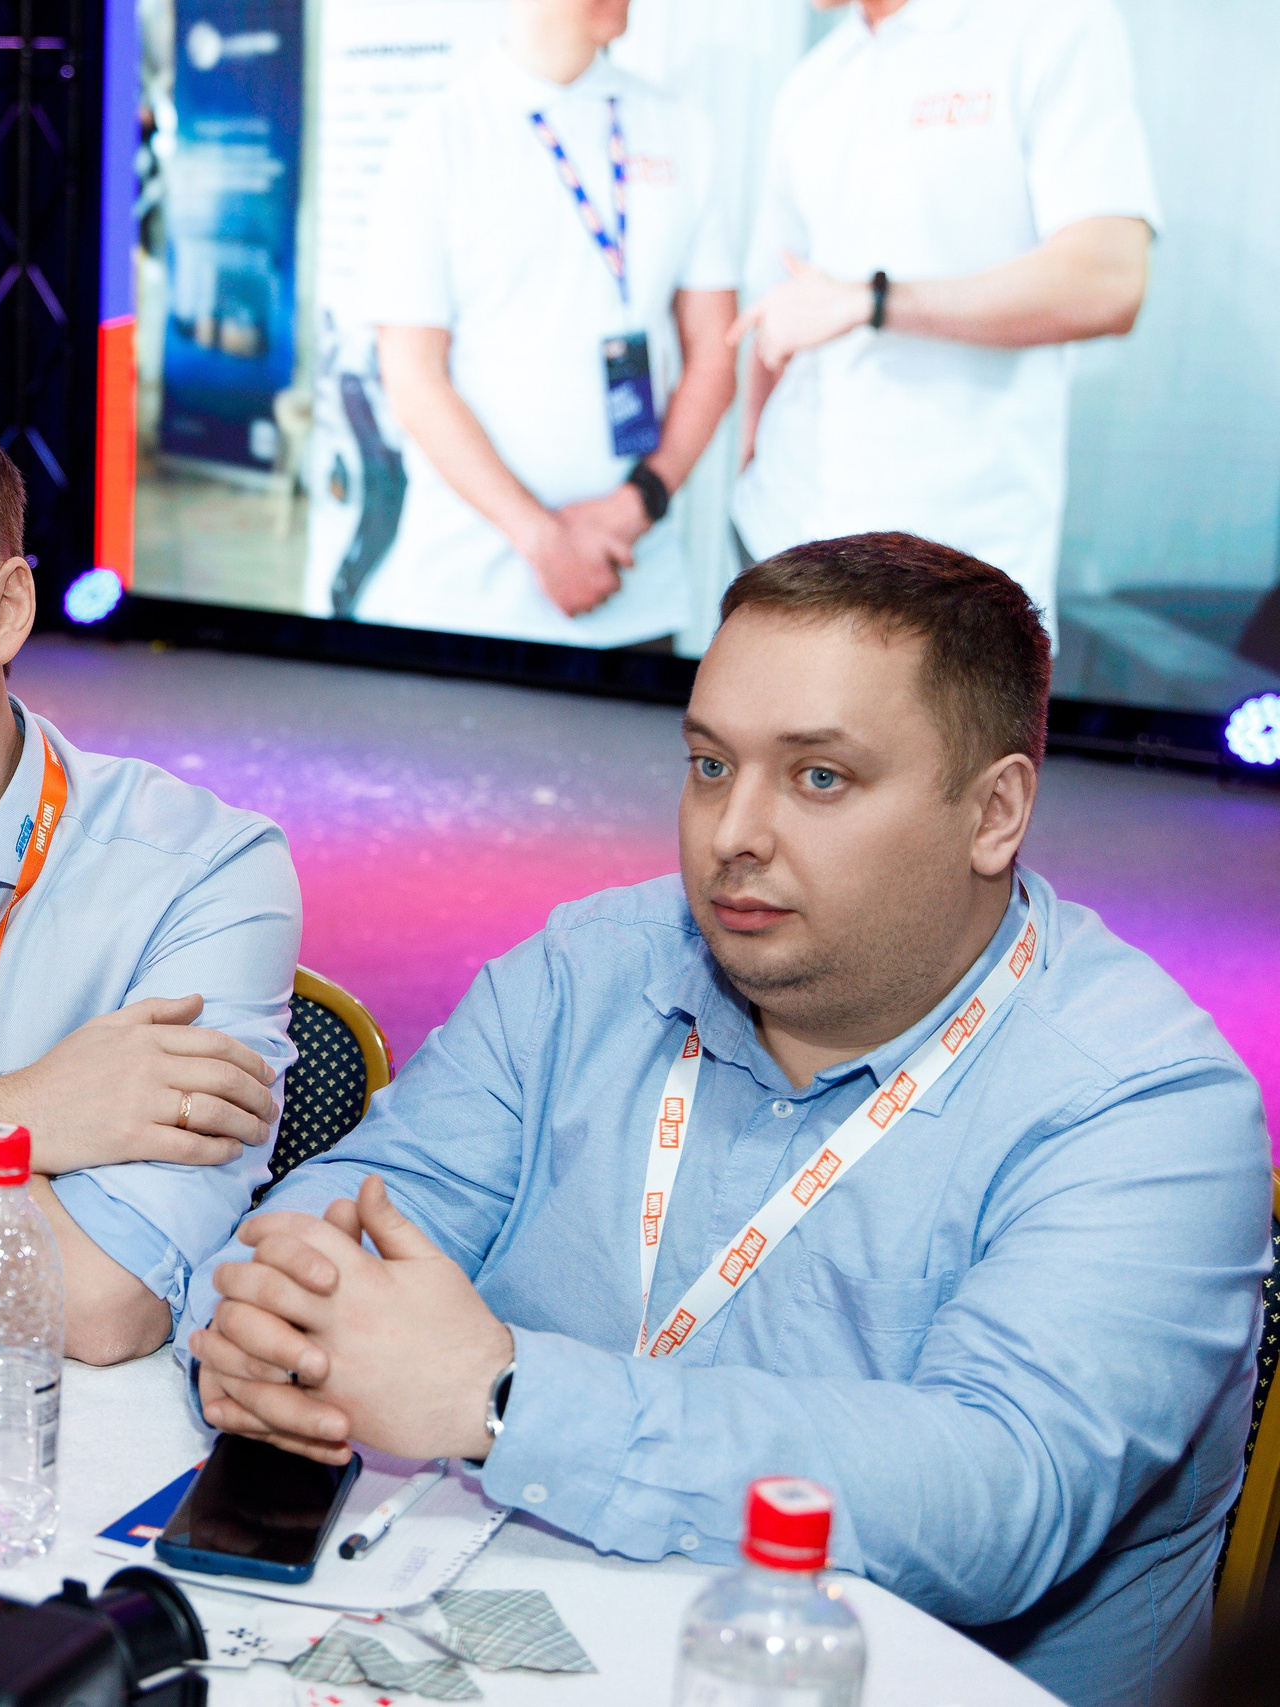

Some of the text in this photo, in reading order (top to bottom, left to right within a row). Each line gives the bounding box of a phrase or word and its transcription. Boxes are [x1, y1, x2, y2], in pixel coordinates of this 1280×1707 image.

[35, 803, 55, 853] PART KOM
[943, 1001, 983, 1051] PART KOM
[661, 1099, 682, 1146] PART KOM
[870, 1075, 914, 1125] PART KOM
[794, 1152, 839, 1203] PART KOM
[645, 1194, 661, 1243] PART KOM
[721, 1230, 763, 1282] PART KOM
[668, 1312, 693, 1342] PART
